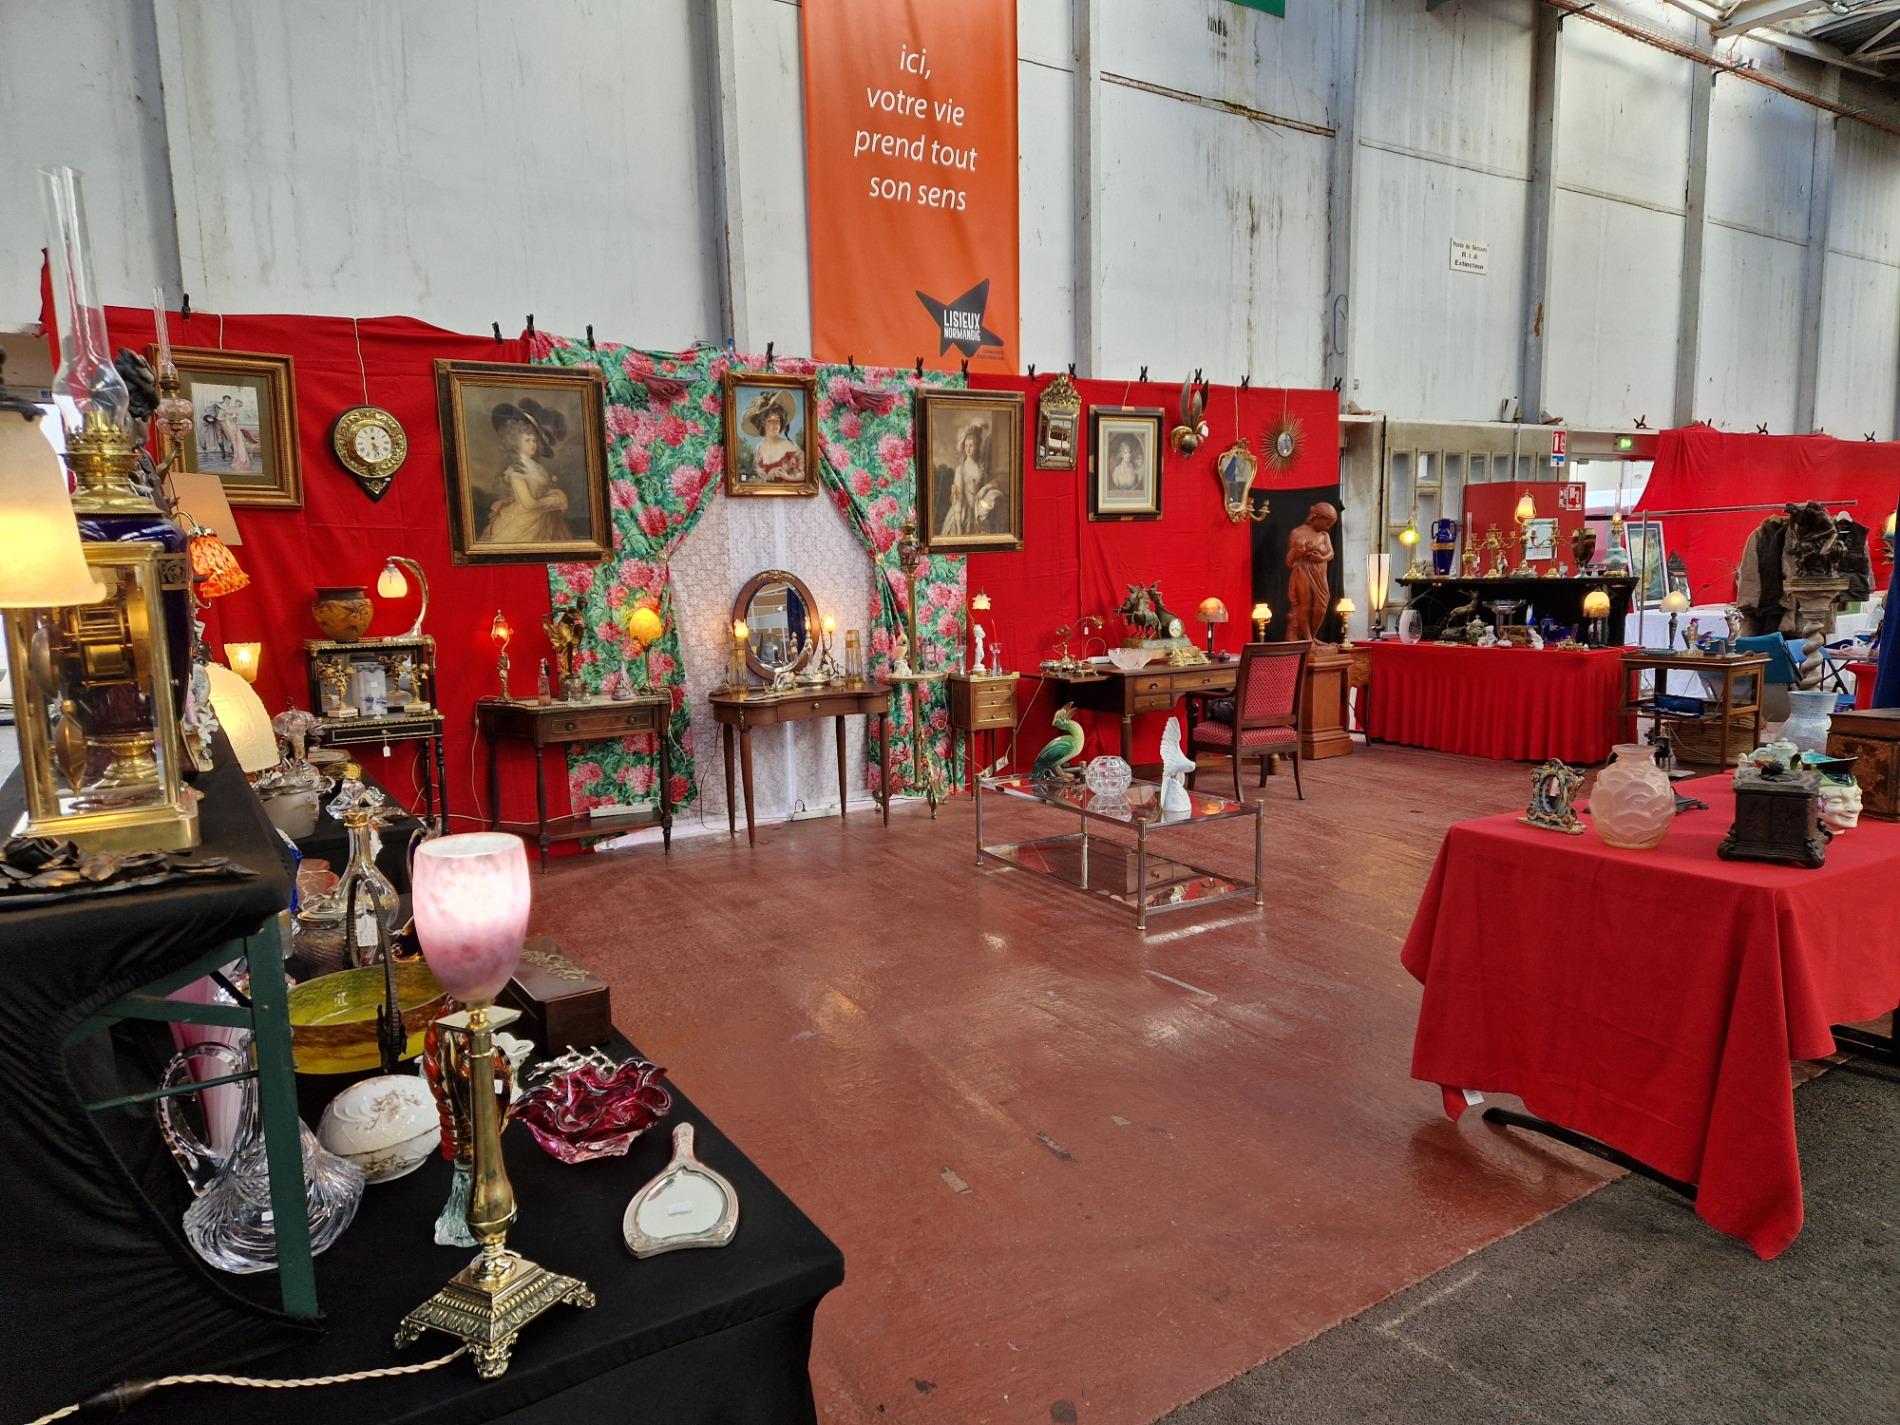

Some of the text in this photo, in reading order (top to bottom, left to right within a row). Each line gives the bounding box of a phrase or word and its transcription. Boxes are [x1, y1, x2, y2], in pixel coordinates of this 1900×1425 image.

[900, 44, 932, 80] ici,
[866, 87, 965, 126] votre vie
[853, 130, 978, 171] prend tout
[869, 176, 967, 210] son sens
[1454, 260, 1484, 270] Extincteur
[943, 309, 981, 330] LISIEUX
[943, 326, 981, 341] NORMANDIE
